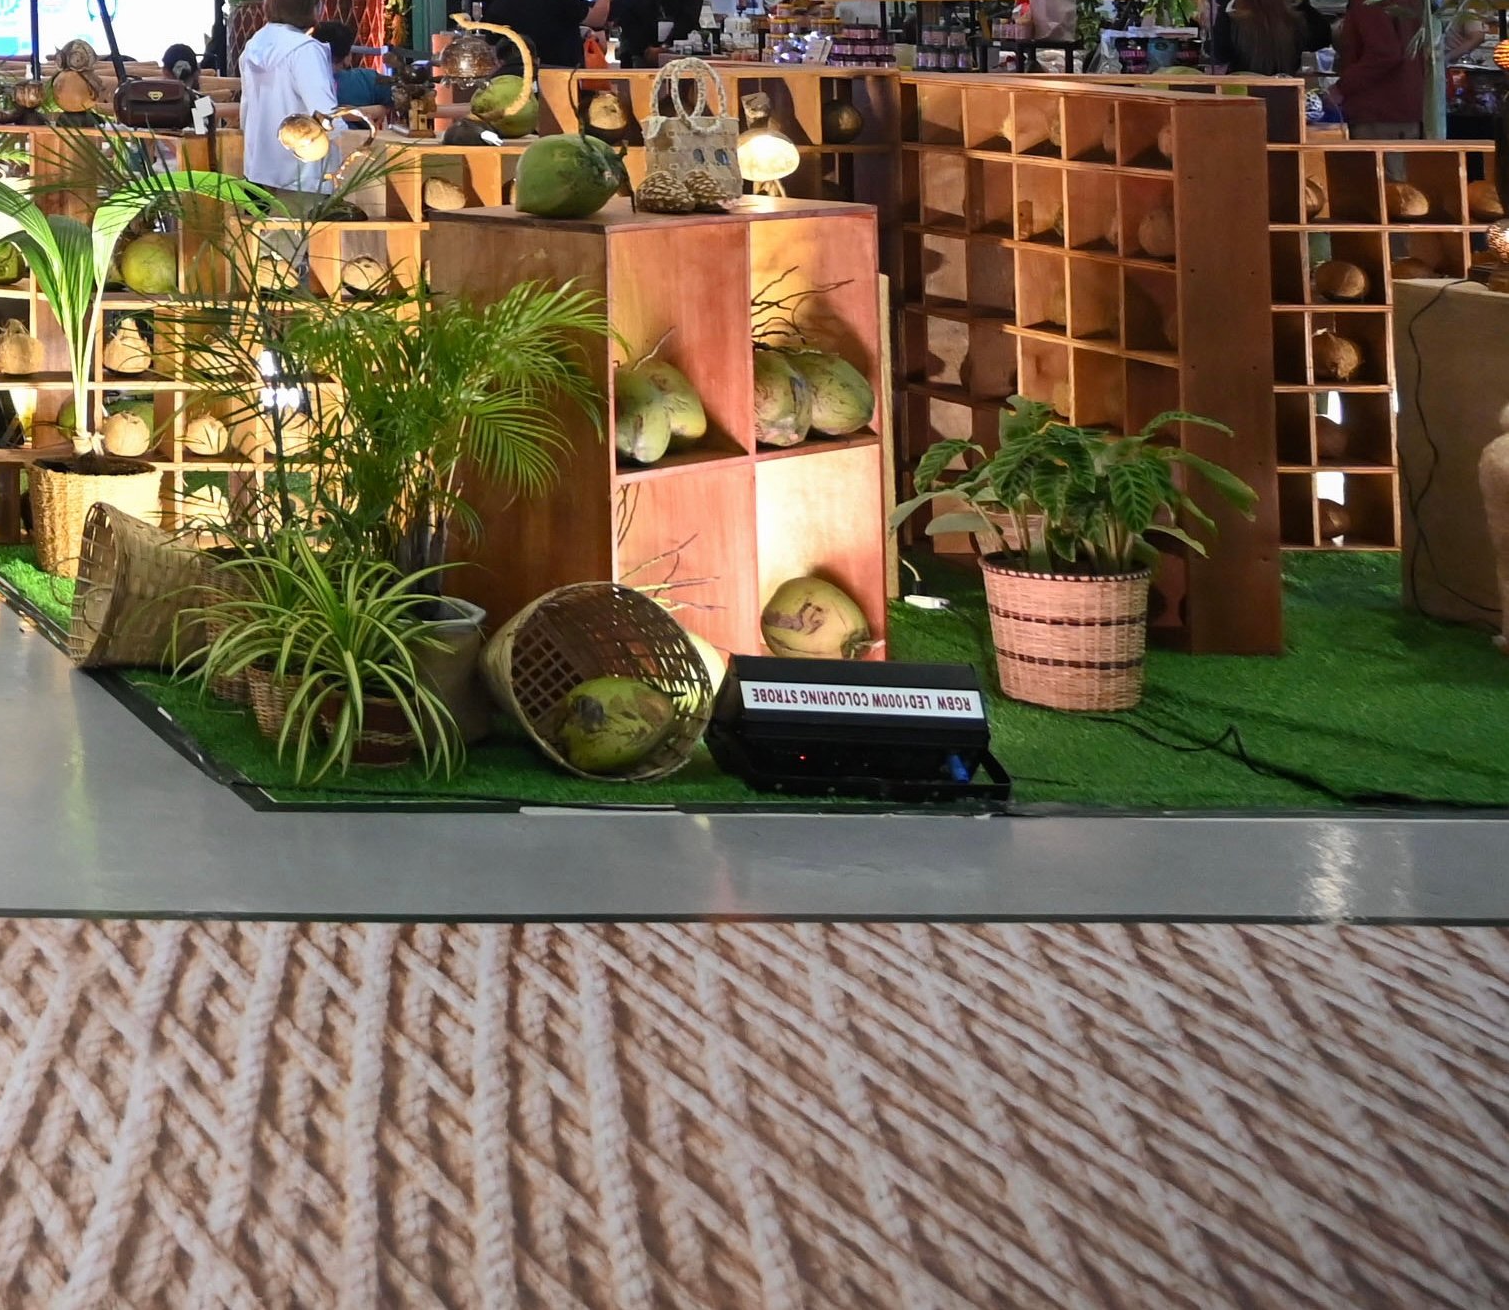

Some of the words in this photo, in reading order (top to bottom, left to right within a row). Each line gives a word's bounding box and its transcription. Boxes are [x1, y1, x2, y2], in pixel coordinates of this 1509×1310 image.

[753, 688, 798, 704] STROBE
[800, 689, 869, 707] COLOURING
[872, 692, 932, 710] LED1000W
[937, 695, 972, 711] RGBW
